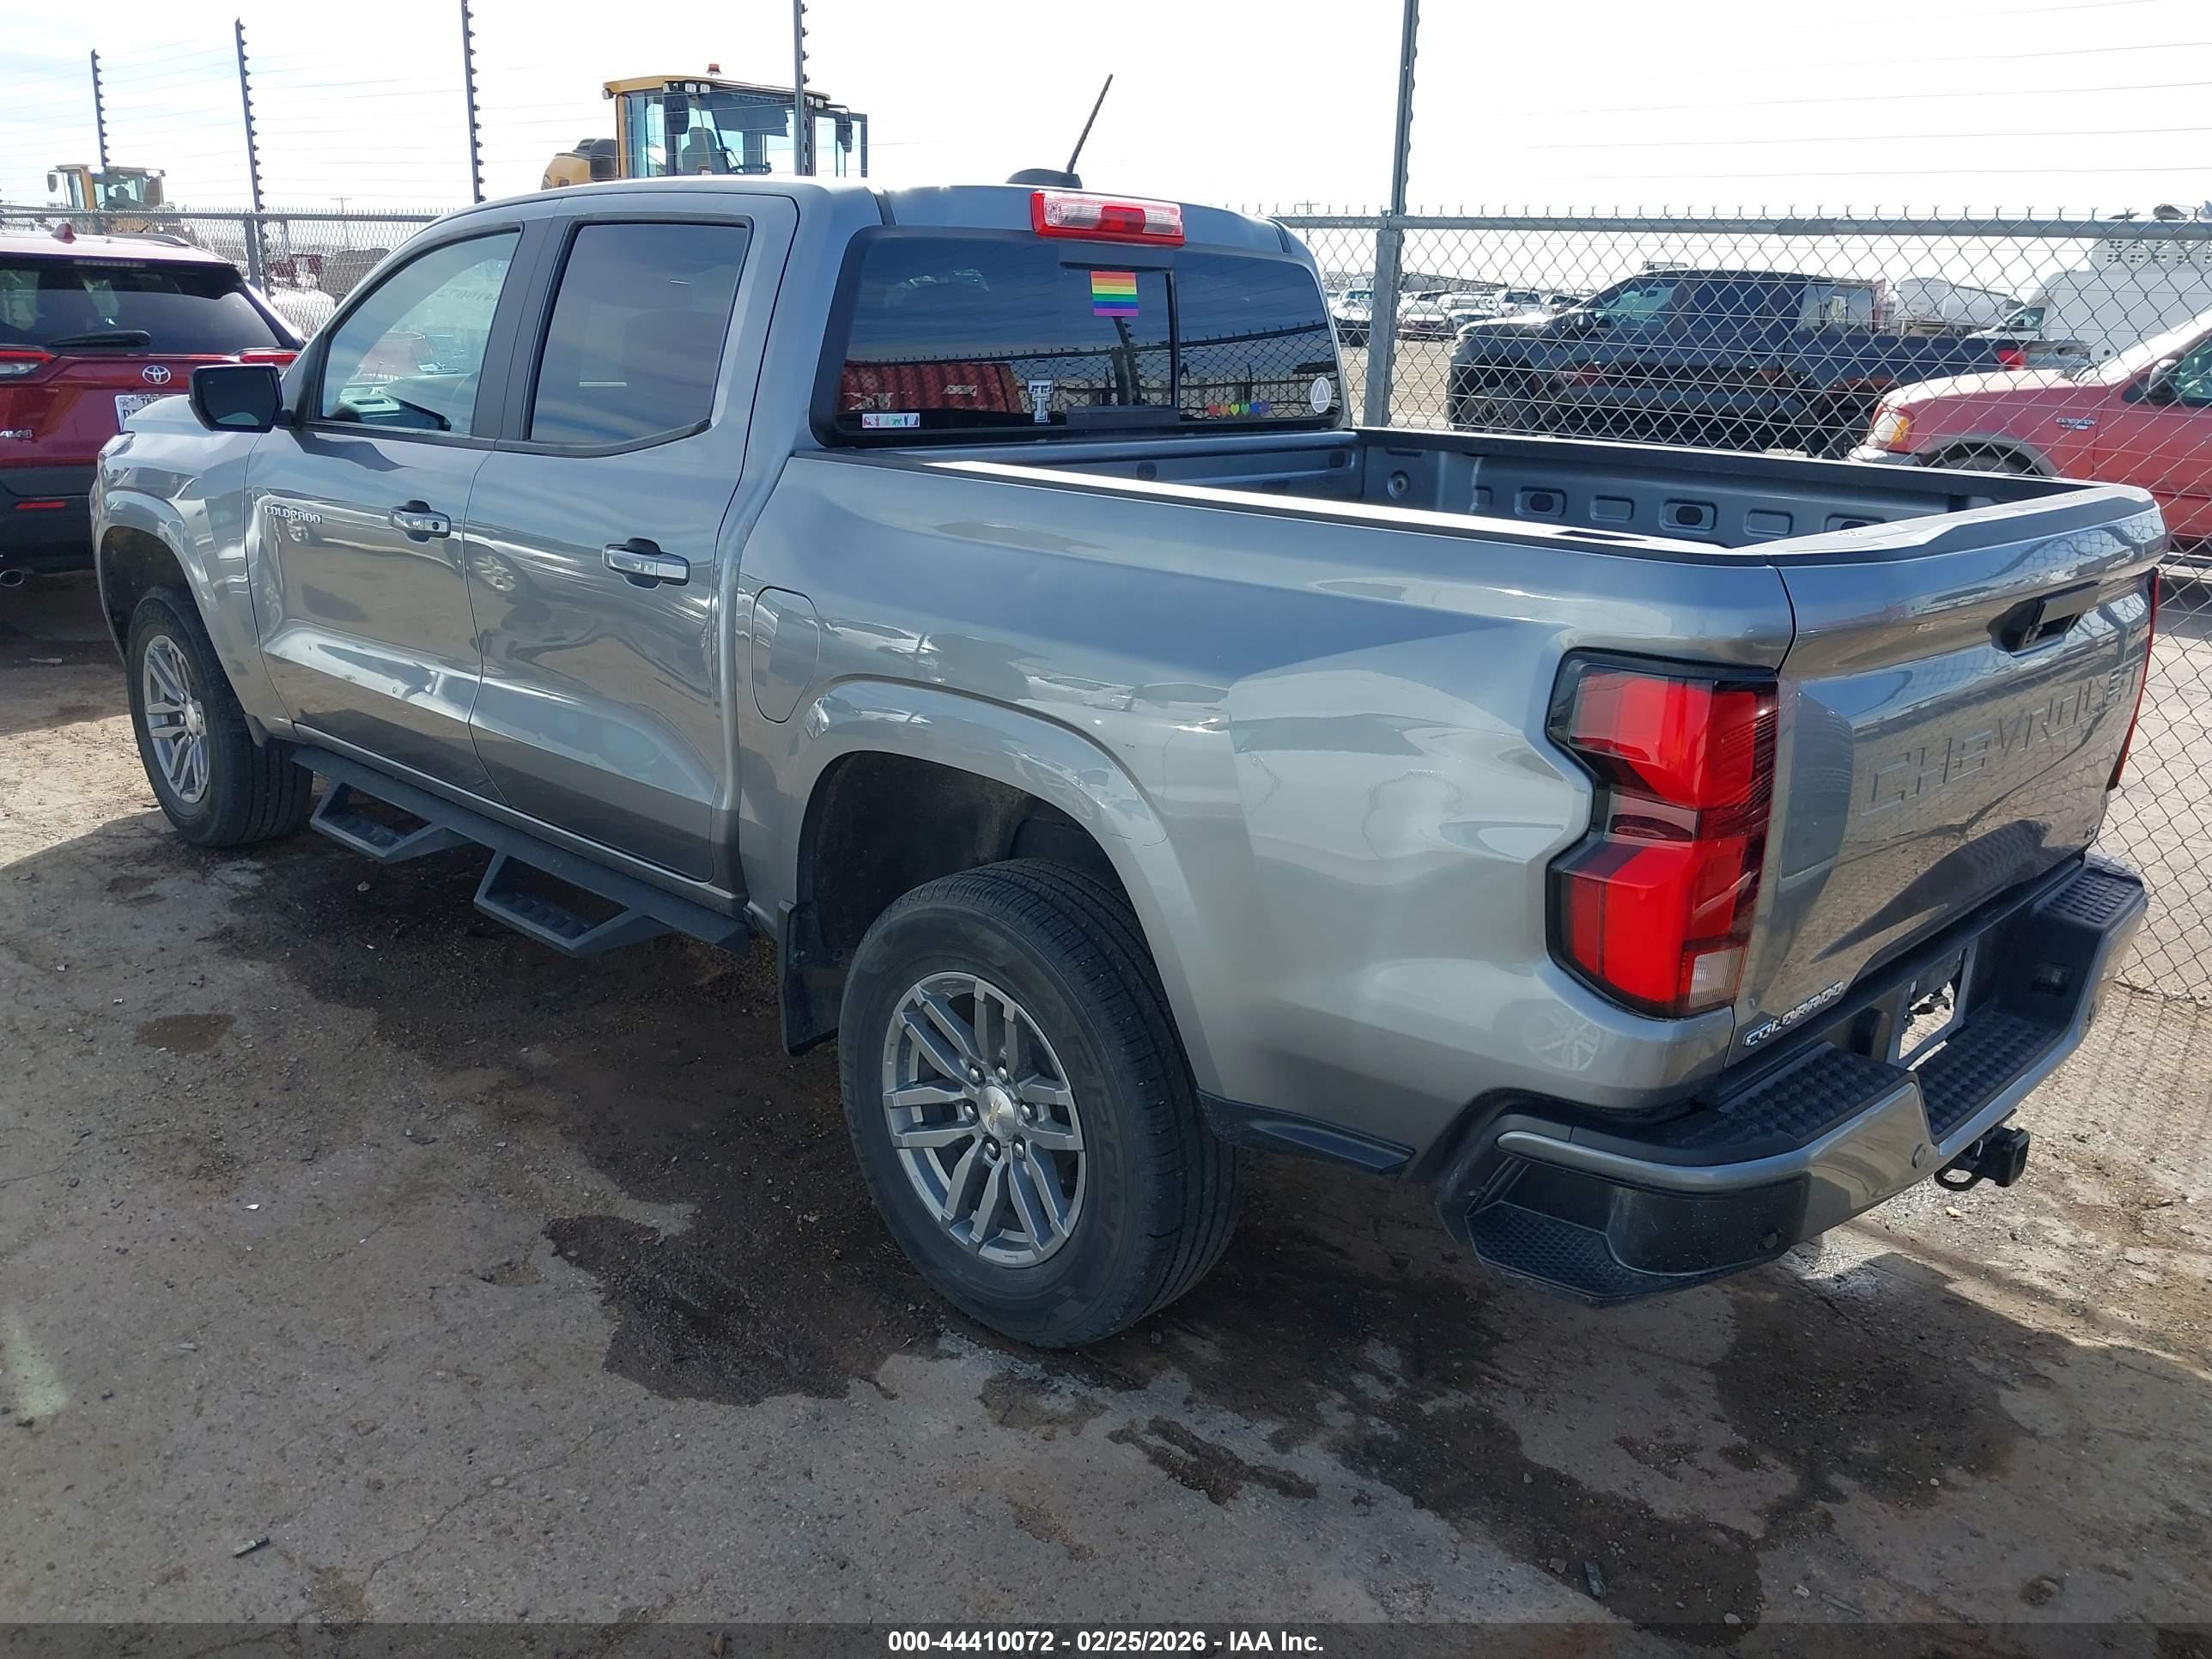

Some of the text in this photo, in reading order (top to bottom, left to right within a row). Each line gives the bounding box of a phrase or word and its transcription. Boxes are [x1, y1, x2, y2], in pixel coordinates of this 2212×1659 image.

[139, 398, 160, 406] TEX
[264, 505, 323, 524] COLORADO
[1862, 659, 2142, 816] CHEVROLET
[1742, 980, 1844, 1047] COLORADO
